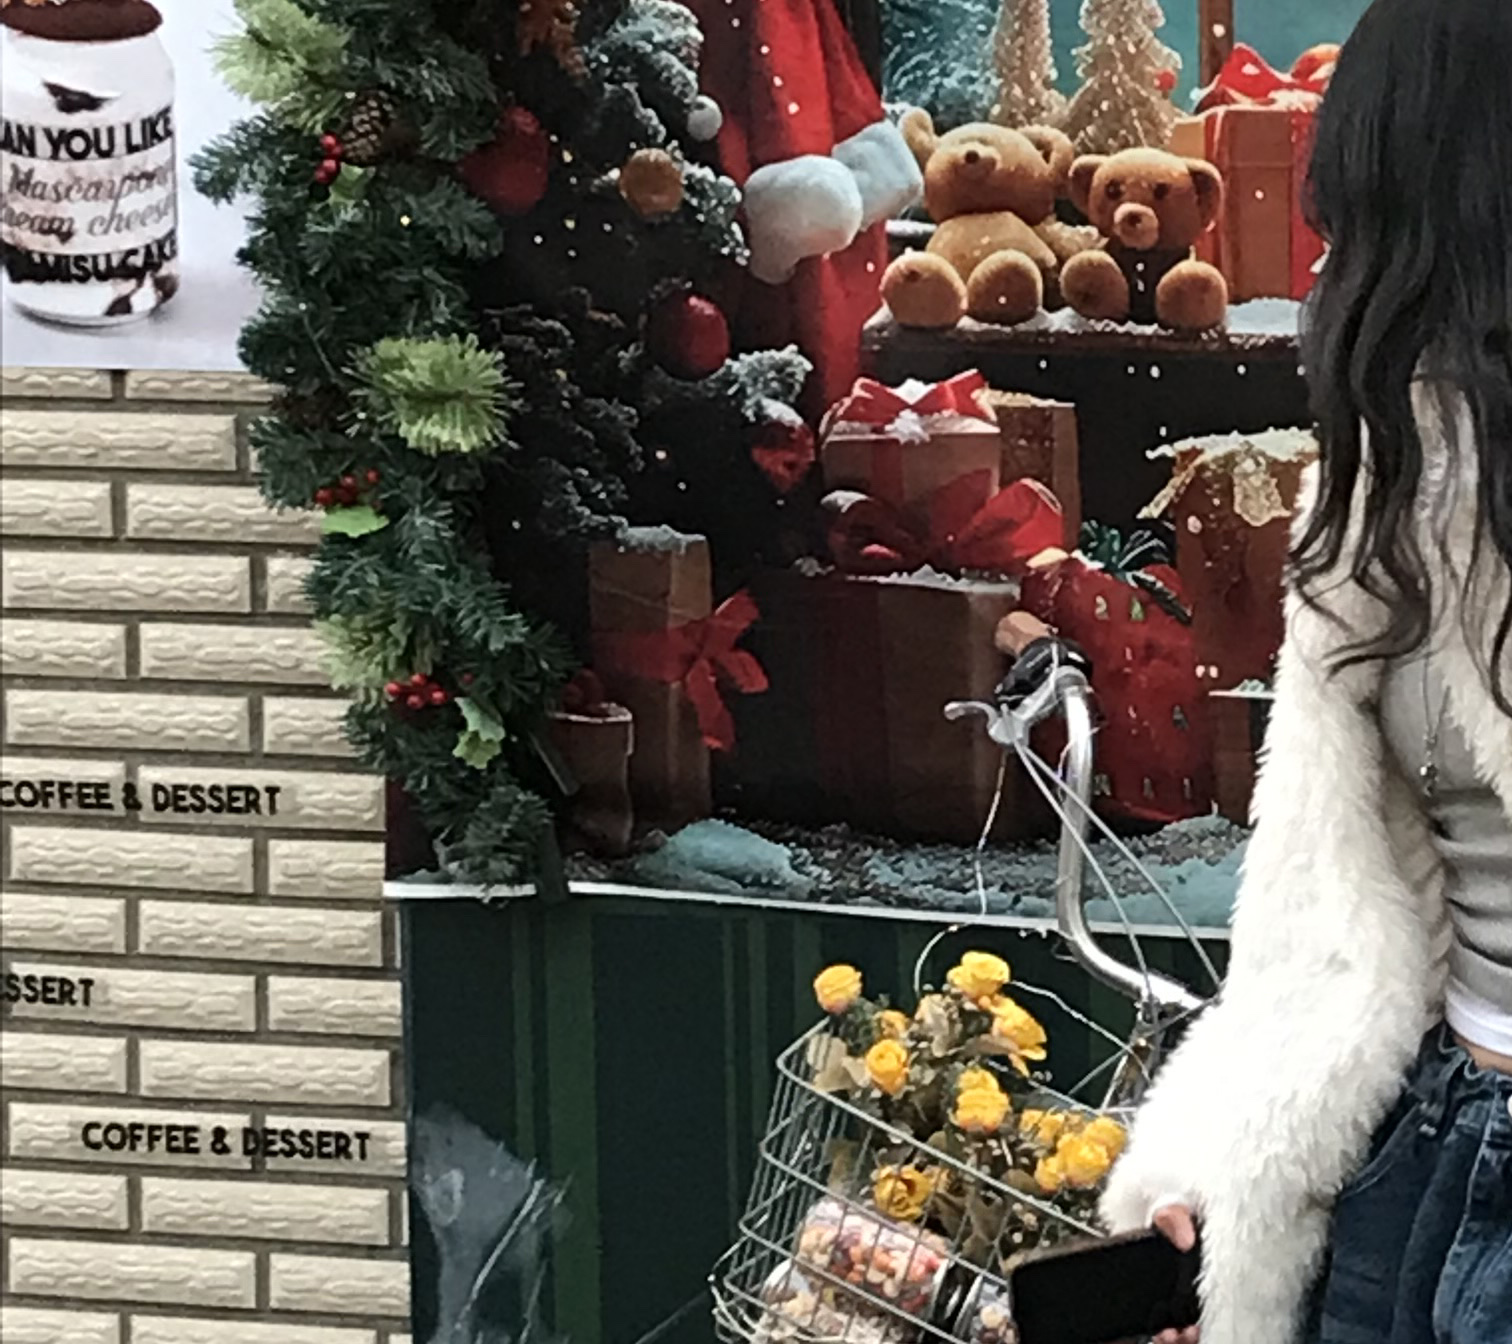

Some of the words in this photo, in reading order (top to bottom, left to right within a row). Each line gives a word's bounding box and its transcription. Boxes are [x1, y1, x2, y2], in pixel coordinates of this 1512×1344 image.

[0, 120, 36, 158] AN
[43, 126, 115, 161] YOU
[121, 781, 142, 813] &
[152, 783, 282, 816] DESSERT
[0, 973, 95, 1007] SSERT
[80, 1121, 201, 1155] COFFEE
[210, 1125, 232, 1156] &
[242, 1127, 371, 1161] DESSERT
